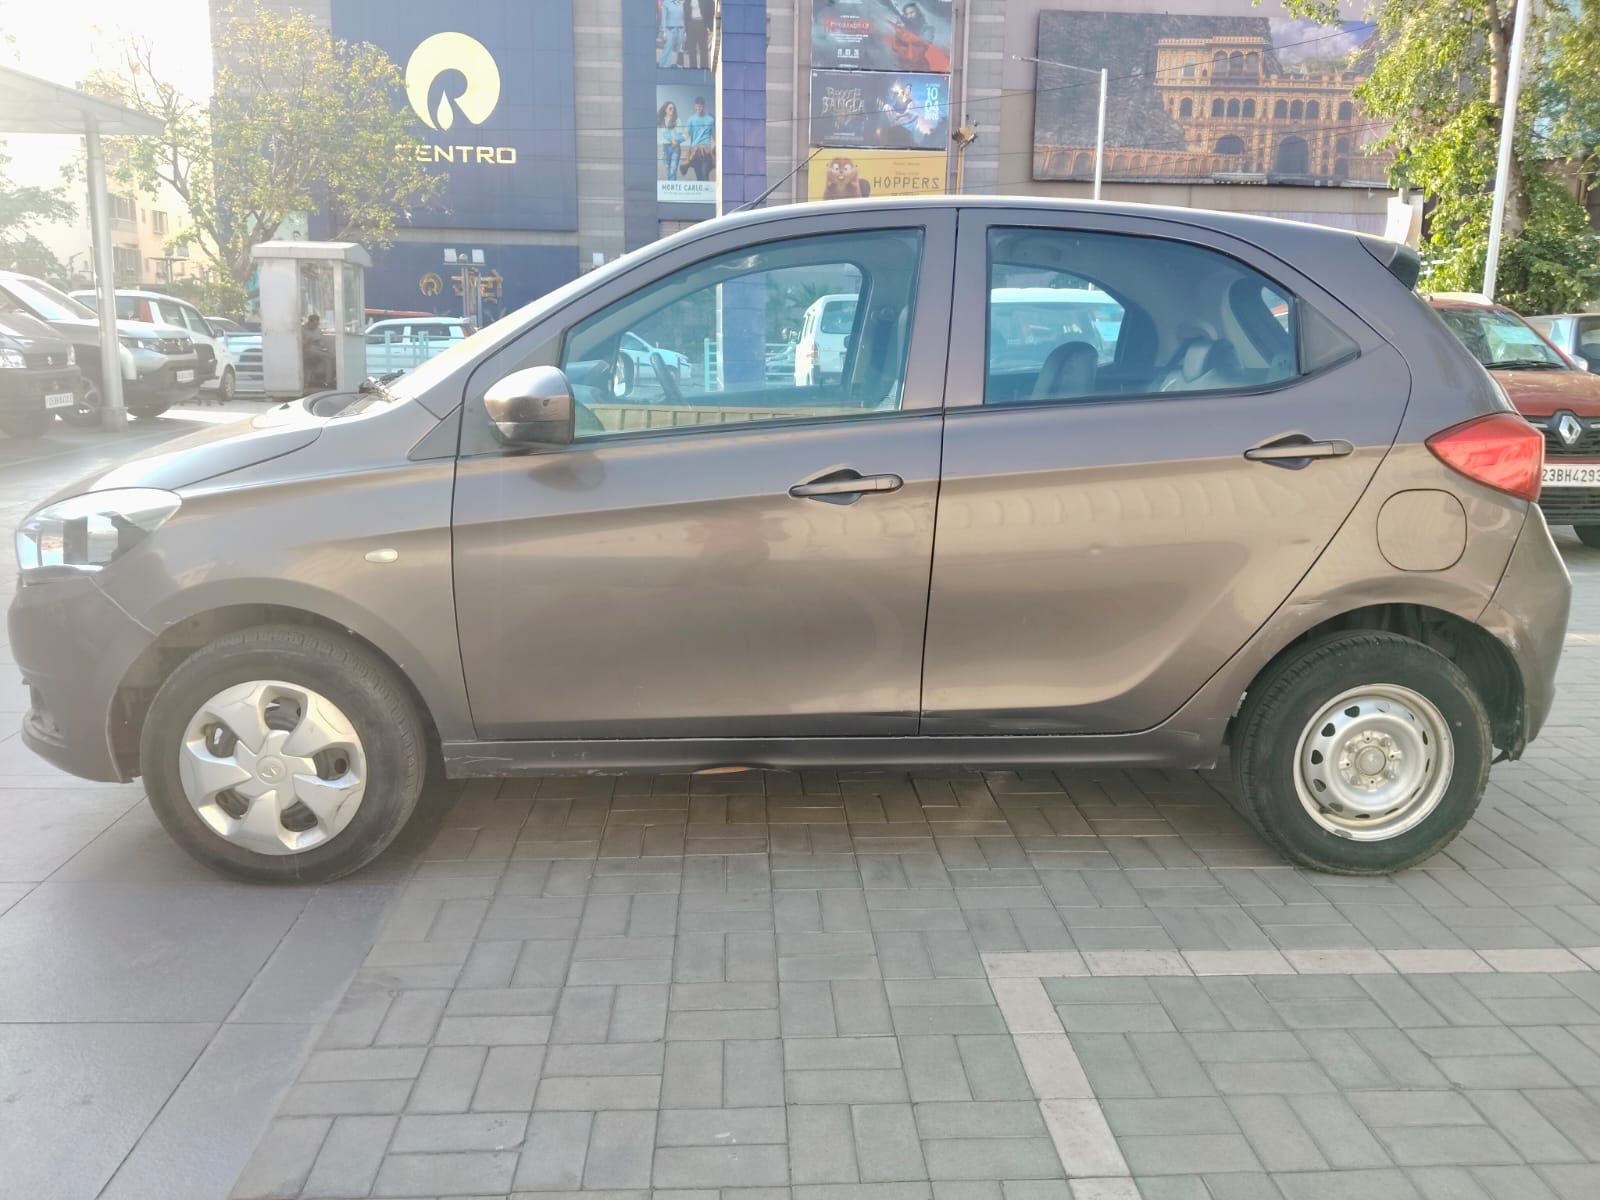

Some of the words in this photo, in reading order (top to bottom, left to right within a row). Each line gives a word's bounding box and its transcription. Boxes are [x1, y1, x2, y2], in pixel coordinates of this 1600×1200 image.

[661, 183, 682, 192] MONTE
[683, 184, 703, 192] CARLO
[873, 176, 940, 189] HOPPERS
